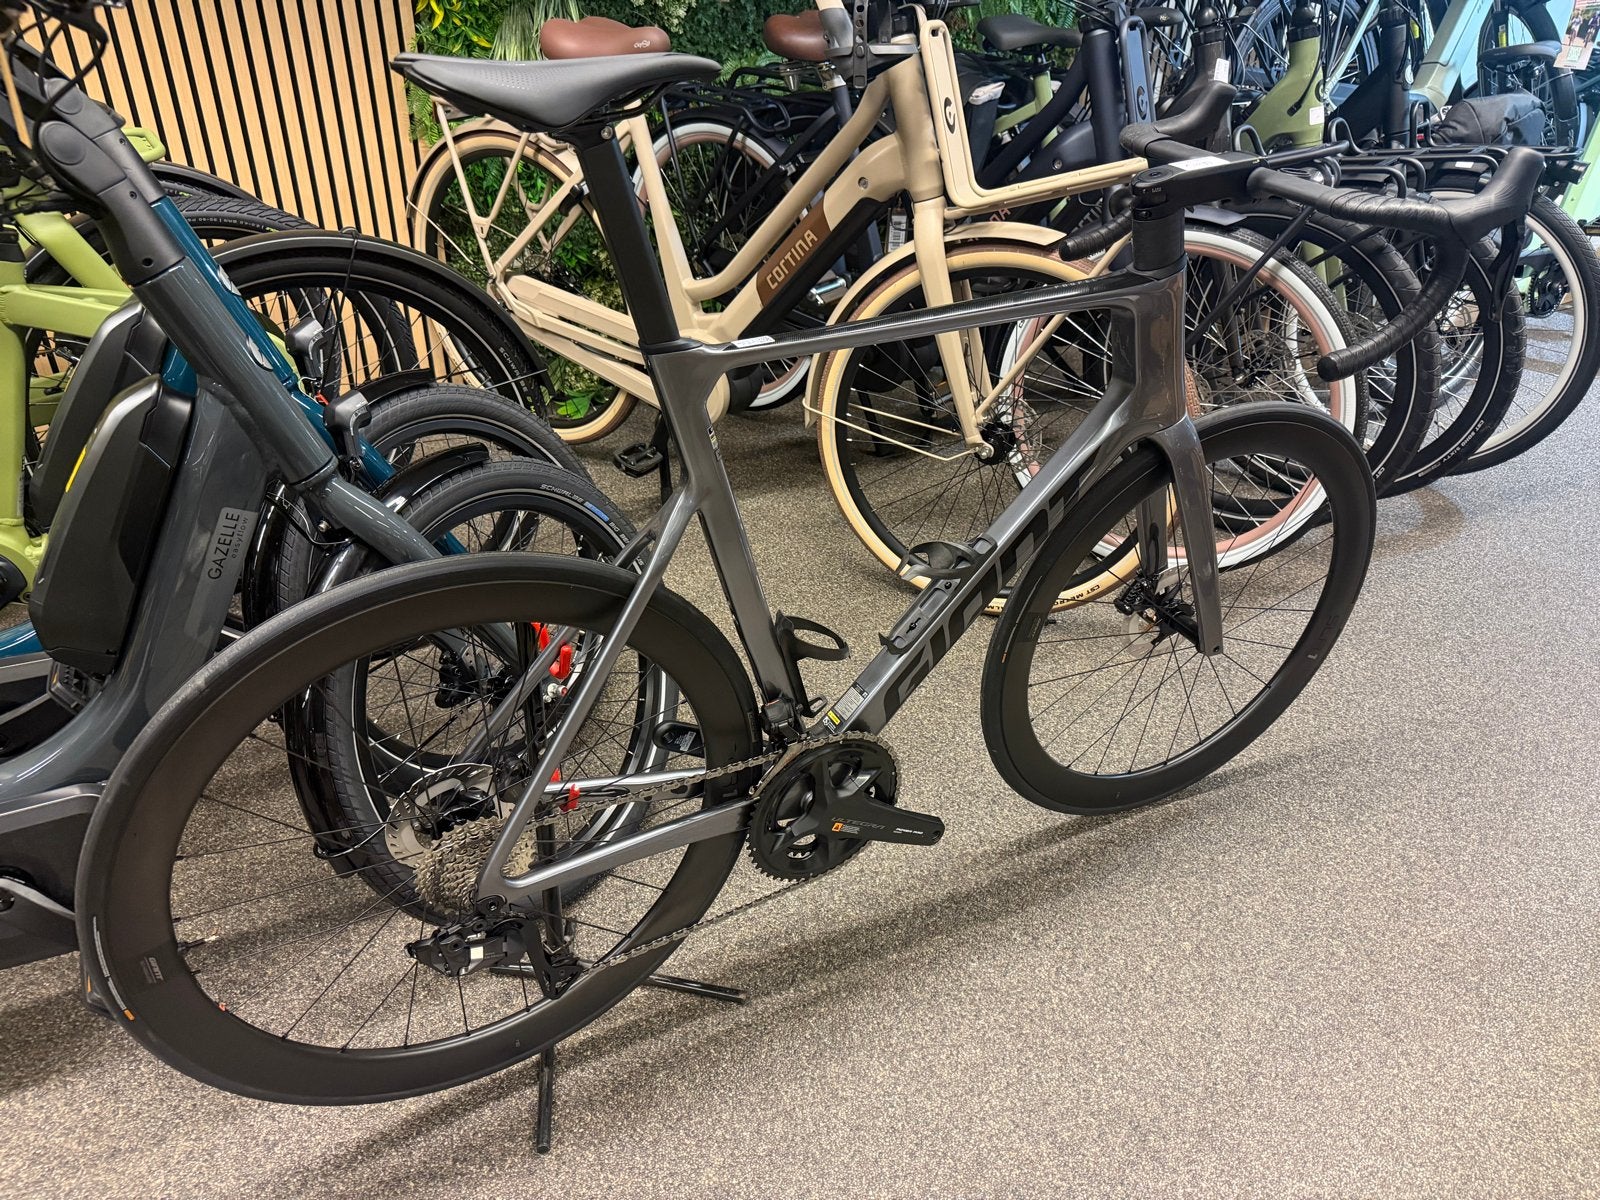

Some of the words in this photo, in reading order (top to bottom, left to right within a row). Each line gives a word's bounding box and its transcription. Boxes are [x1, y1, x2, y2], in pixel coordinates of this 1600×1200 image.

[499, 346, 529, 393] SCHWABE
[207, 512, 240, 580] GAZELLE
[231, 517, 249, 559] easyflow
[1086, 584, 1100, 595] CST
